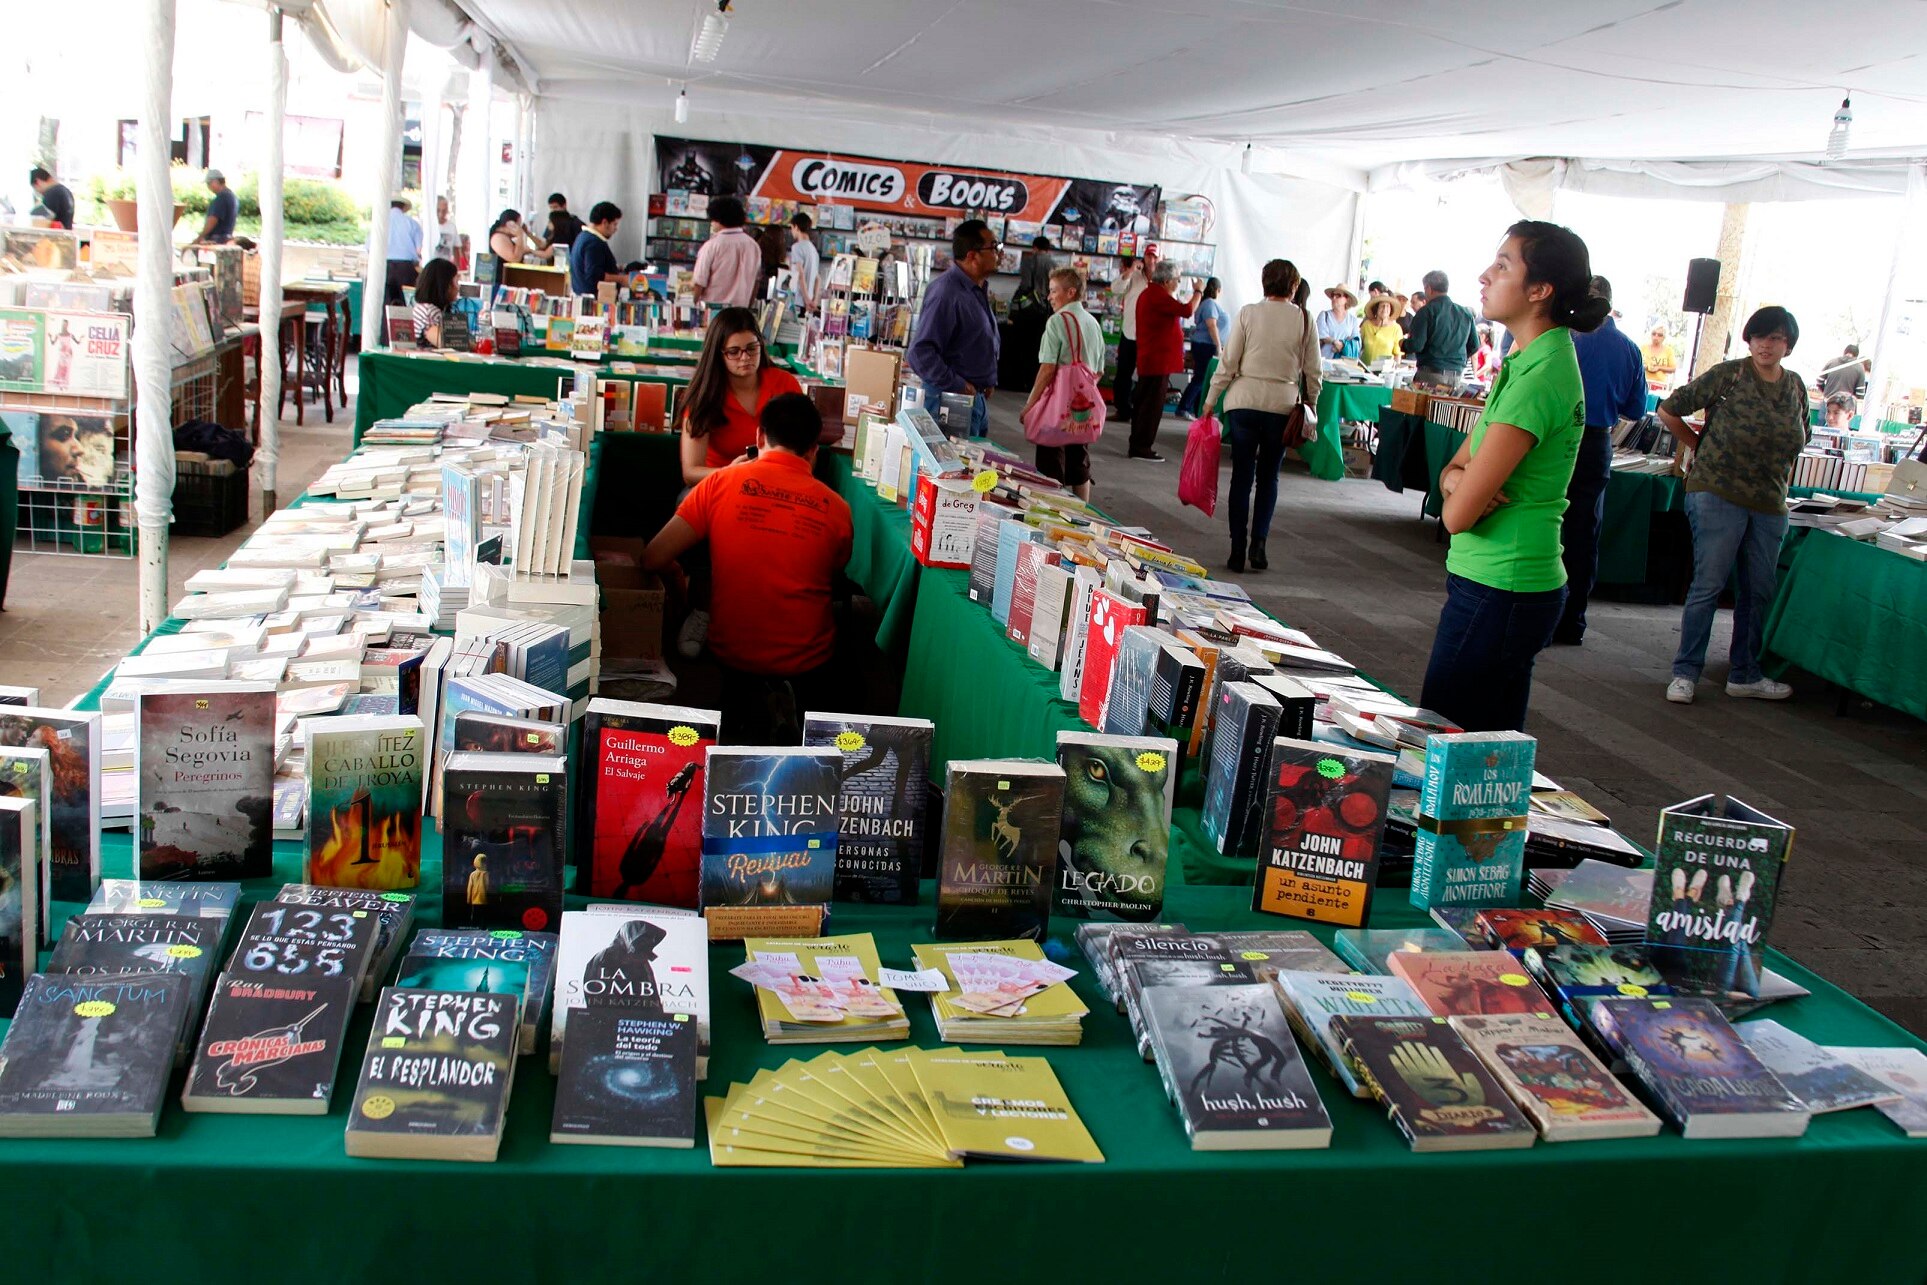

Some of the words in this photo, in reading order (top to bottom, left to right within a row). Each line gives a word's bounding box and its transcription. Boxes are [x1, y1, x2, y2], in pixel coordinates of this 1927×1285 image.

[801, 161, 895, 197] COMICS
[904, 194, 916, 209] &
[929, 174, 1016, 210] BOOKS
[88, 324, 120, 339] CELIA
[88, 340, 121, 356] CRUZ
[942, 499, 951, 508] de
[952, 499, 975, 513] Greg
[180, 725, 237, 743] Sofía
[605, 736, 665, 755] Guillermo
[165, 744, 252, 769] Segovia
[324, 754, 415, 773] CABALLO
[605, 752, 647, 768] Arriaga
[175, 770, 243, 785] Peregrinos
[324, 776, 348, 789] DE
[357, 771, 414, 788] TROYA
[604, 766, 614, 776] El
[615, 767, 645, 781] Salvaje
[1483, 769, 1498, 781] LOS
[459, 783, 513, 791] STEPHEN
[519, 784, 549, 792] KING
[712, 794, 836, 815] STEPHEN
[839, 795, 884, 814] JOHN
[728, 820, 816, 838] KING
[839, 816, 914, 837] ZENBACH
[839, 845, 889, 857] ERSONAS
[1300, 833, 1342, 856] JOHN
[51, 851, 79, 865] BRAS
[837, 859, 902, 872] CONOCIDAS
[1271, 848, 1365, 880] KATZENBACH
[1684, 850, 1708, 865] DE
[1714, 853, 1751, 870] UNA
[727, 850, 812, 884] Revival
[953, 862, 1046, 885] MARTIN
[978, 863, 1009, 871] GEORGE
[1446, 867, 1476, 884] SIMON
[1478, 864, 1510, 882] SEBAG
[1062, 869, 1155, 895] LEGADO
[1279, 877, 1296, 888] un
[1302, 880, 1351, 898] asunto
[311, 889, 380, 900] JEFFERY
[1011, 888, 1035, 896] REYES
[1276, 889, 1350, 910] pendiente
[1442, 882, 1509, 902] MONTEFIORE
[280, 895, 401, 912] DEAVER
[1061, 898, 1119, 910] CHRISTOPHER
[1119, 901, 1152, 911] PAOLINI
[81, 918, 160, 930] GEORGE
[1655, 908, 1762, 944] amistad
[75, 928, 202, 945] MARTIN
[422, 935, 548, 949] STEPHEN
[1134, 938, 1208, 951] silencio
[317, 940, 357, 950] PENSANDO
[437, 948, 526, 962] KING
[1205, 953, 1226, 961] hush
[600, 967, 627, 980] LA
[1228, 971, 1248, 979] hush
[1429, 961, 1456, 973] La
[1462, 961, 1507, 978] daga
[226, 980, 264, 991] Ray
[885, 973, 923, 983] TOME
[38, 985, 166, 1004] SANCTUM
[229, 987, 317, 1001] BRADBURY
[566, 980, 695, 998] SOMBRA
[389, 992, 503, 1014] STEPHEN
[565, 997, 604, 1007] JOHN
[608, 998, 698, 1009] KATZENBACH
[385, 1007, 501, 1041] KING
[617, 1027, 674, 1037] HAWKING
[618, 1018, 668, 1029] STEPHEN
[669, 1022, 684, 1031] W.
[208, 1035, 291, 1057] CRÓNICAS
[631, 1035, 661, 1044] teoría
[634, 1043, 658, 1051] todo
[232, 1040, 327, 1066] MARCIANAS
[369, 1055, 386, 1080] EL
[390, 1055, 497, 1090] RESPLANDOR
[22, 1091, 82, 1099] MADELEINE
[86, 1091, 119, 1099] ROUX
[1422, 1076, 1469, 1105] 3
[1258, 1090, 1308, 1111] hush
[977, 1108, 987, 1116] Y
[990, 1109, 1069, 1120] LECTORES
